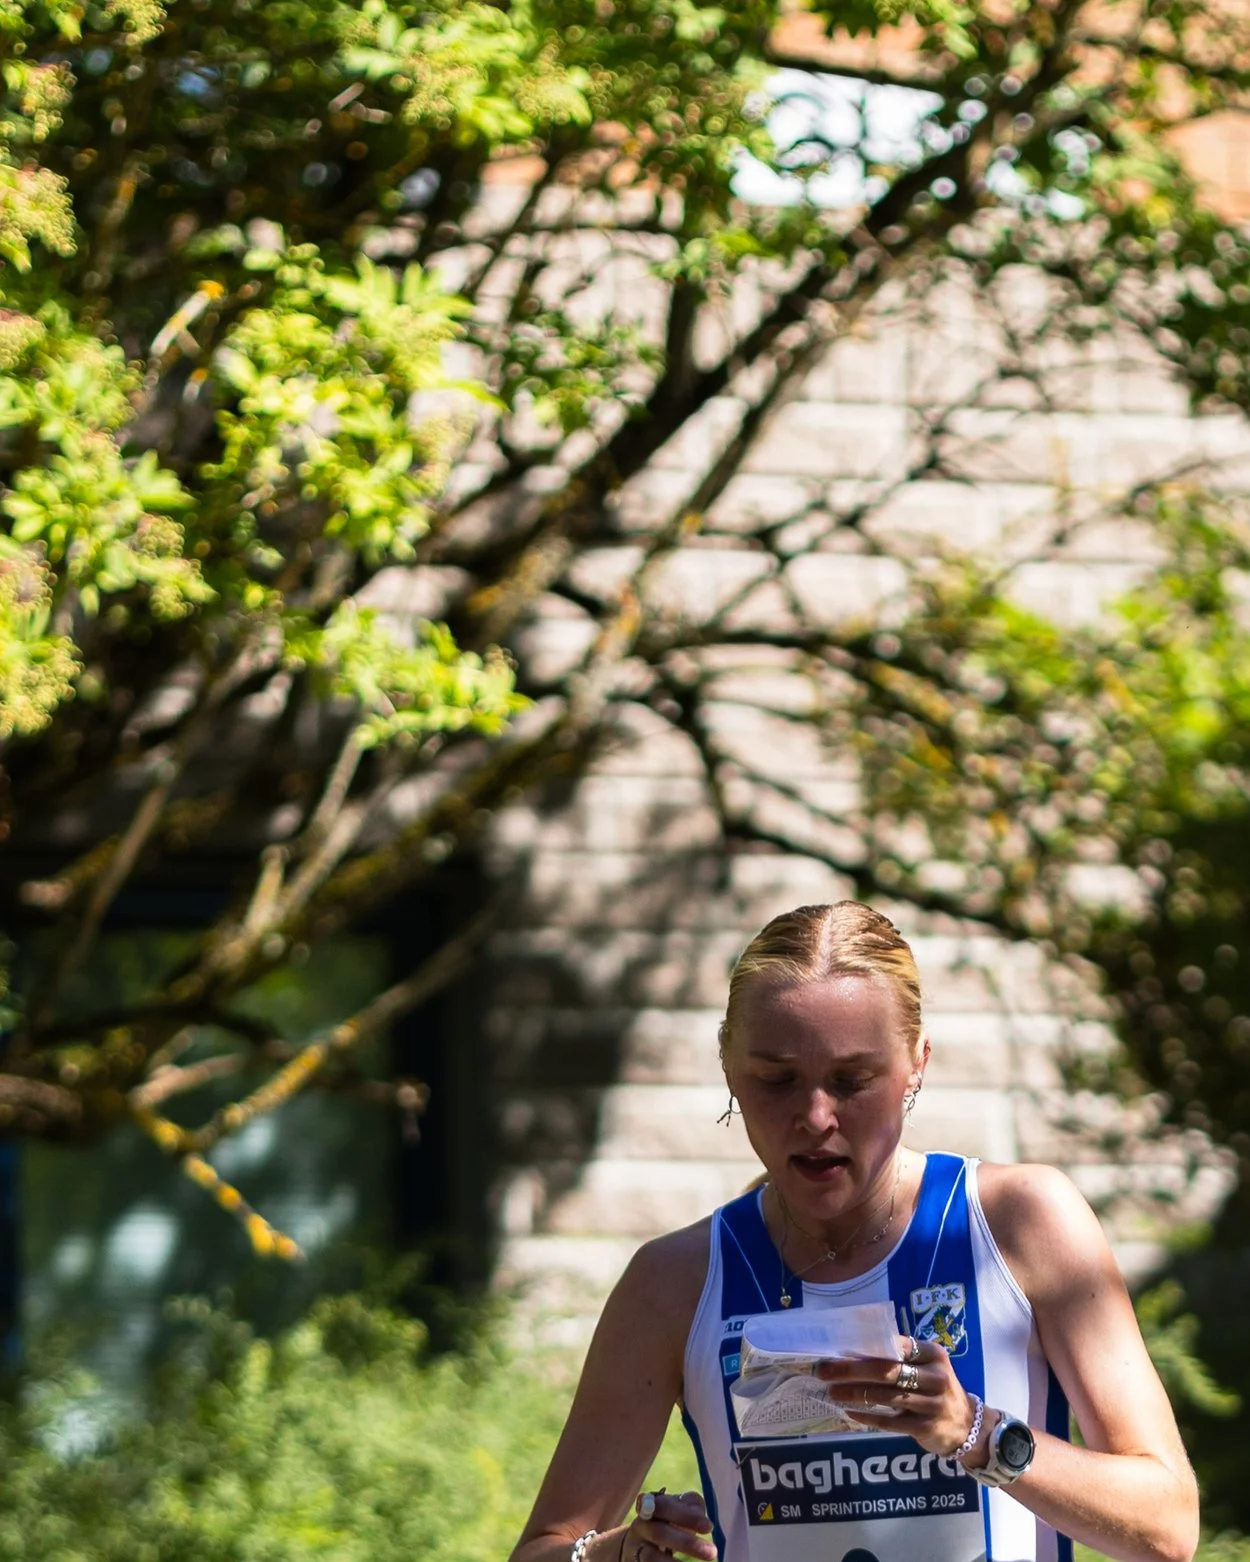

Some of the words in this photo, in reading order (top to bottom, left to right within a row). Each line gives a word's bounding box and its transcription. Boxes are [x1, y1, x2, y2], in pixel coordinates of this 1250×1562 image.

[750, 1452, 968, 1493] bagheera
[781, 1504, 801, 1518] SM
[812, 1496, 927, 1516] SPRINTDISTANS
[931, 1493, 966, 1509] 2025
